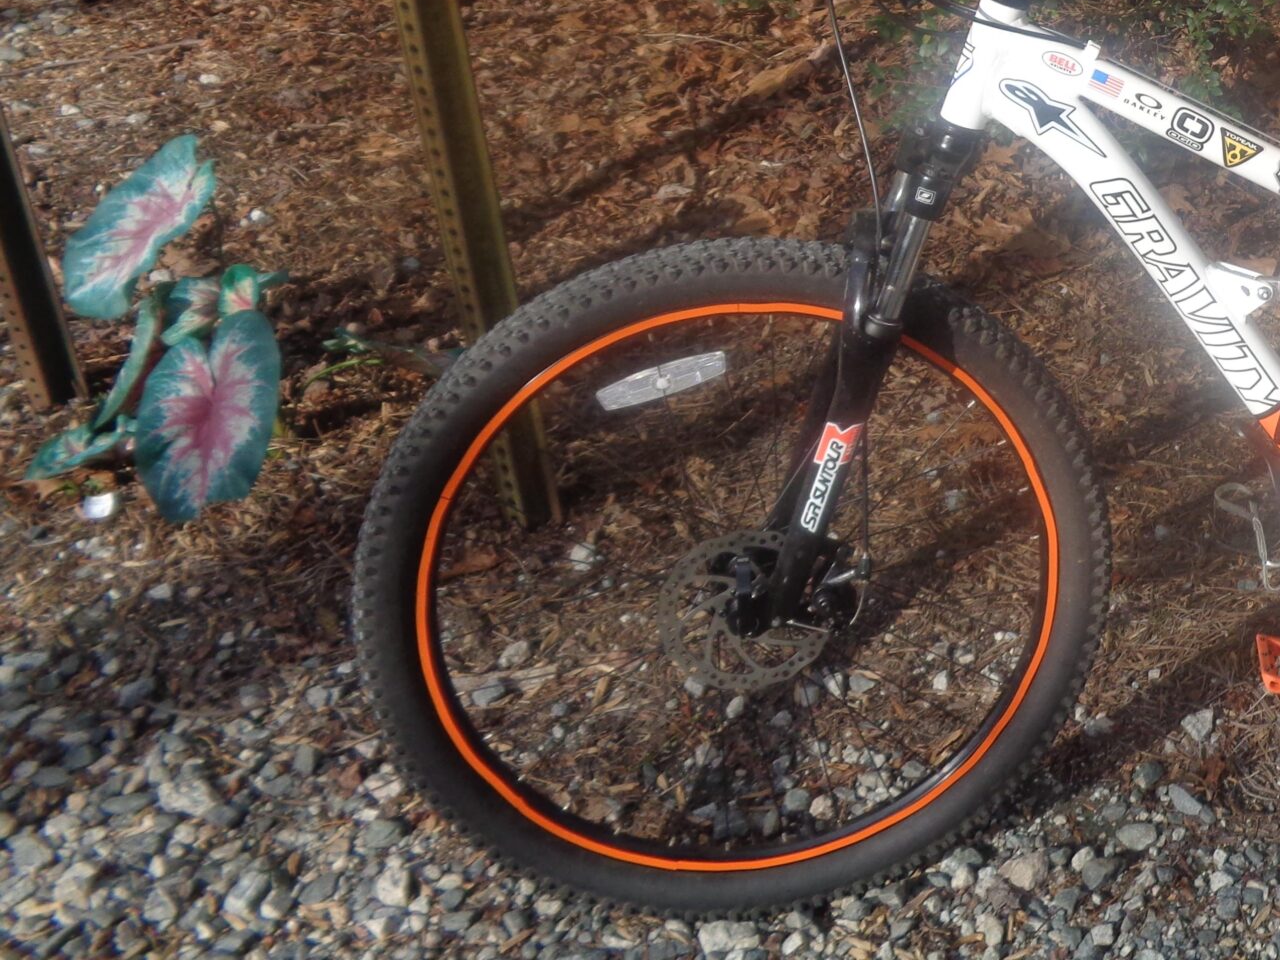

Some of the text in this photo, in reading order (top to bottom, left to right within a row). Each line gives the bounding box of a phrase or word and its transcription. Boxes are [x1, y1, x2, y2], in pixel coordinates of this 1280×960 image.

[1048, 53, 1077, 72] BELL
[1123, 98, 1166, 121] OAKLEY
[1225, 131, 1258, 150] TOPEAK
[1090, 176, 1280, 411] GRAVITY
[803, 440, 846, 533] SR SUNTOUR
